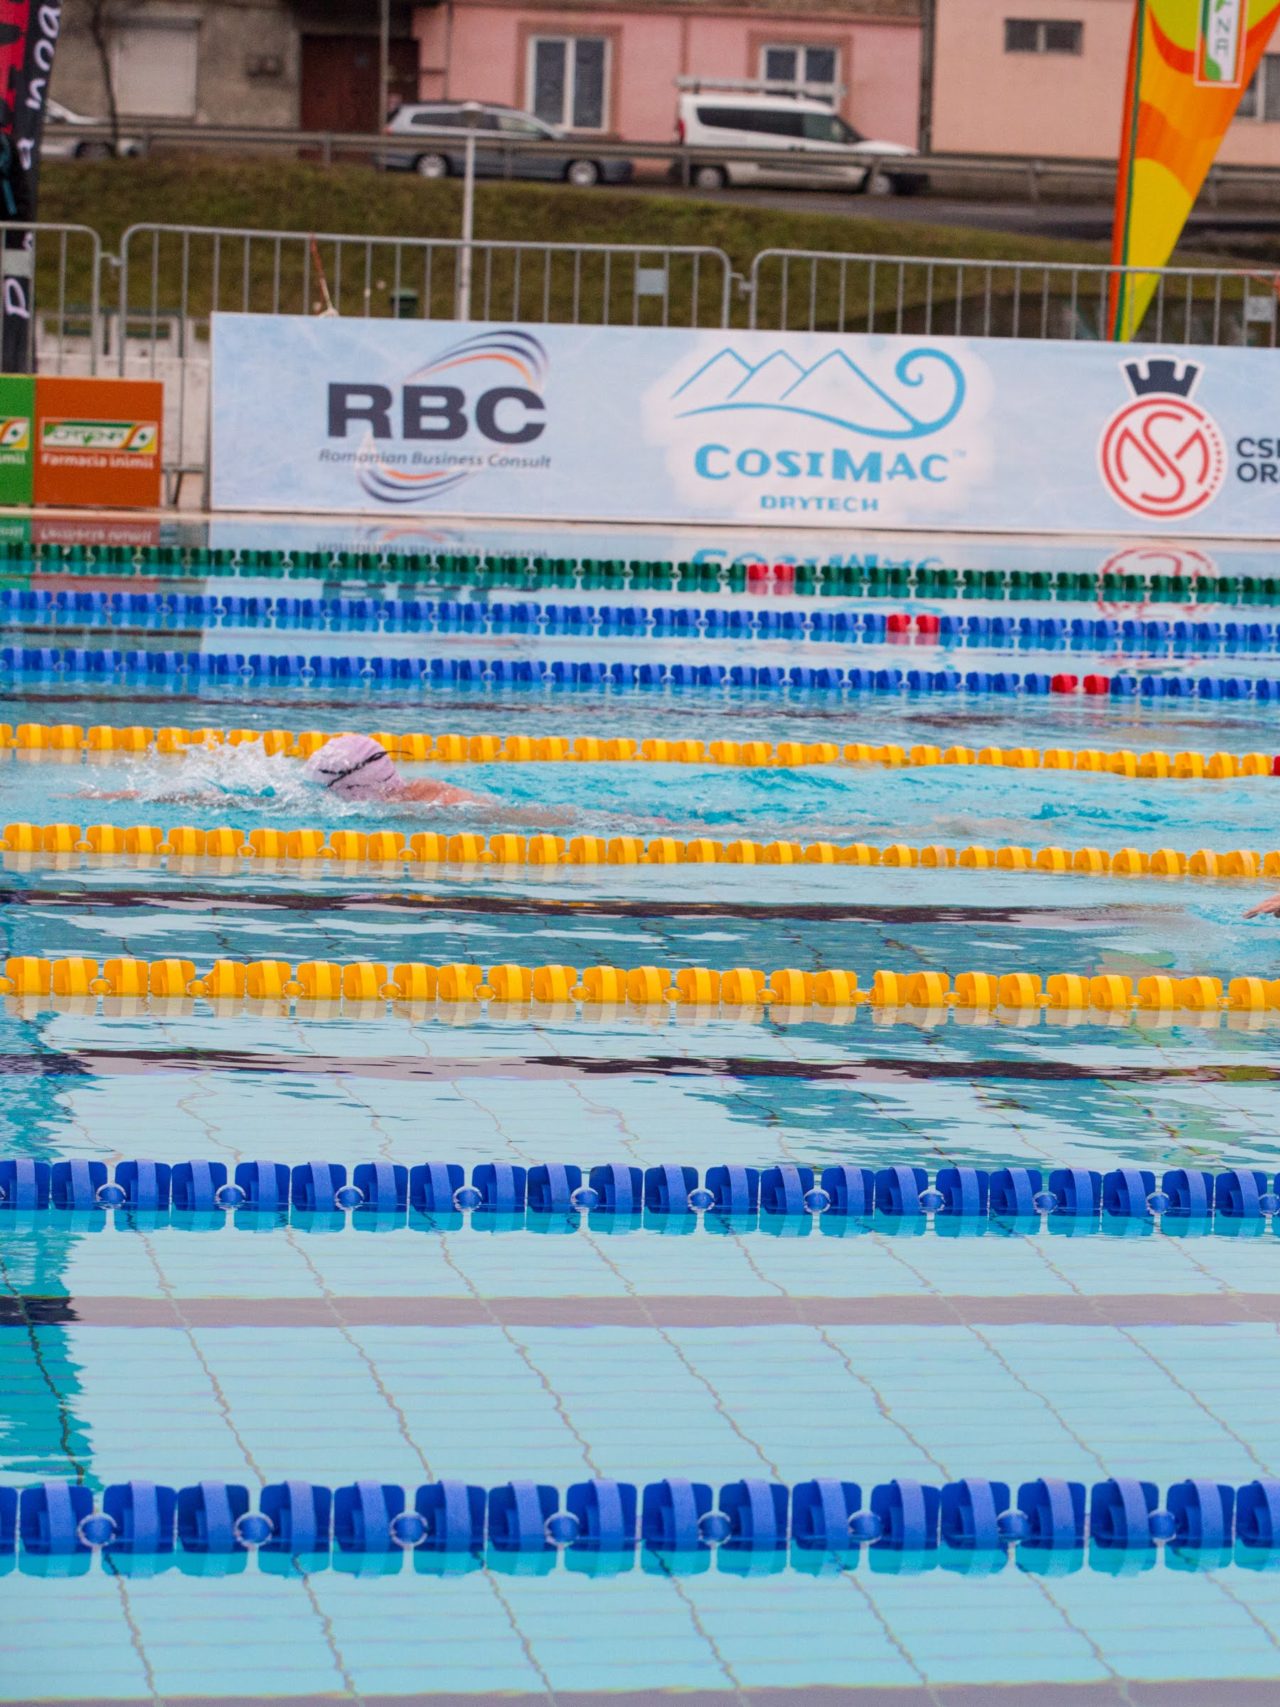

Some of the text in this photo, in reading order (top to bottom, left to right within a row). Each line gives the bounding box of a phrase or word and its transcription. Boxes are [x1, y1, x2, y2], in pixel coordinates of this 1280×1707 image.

[328, 383, 546, 443] RBC
[42, 452, 107, 467] Farmacia
[318, 449, 551, 468] Romanian Business Consult
[760, 495, 879, 512] DRYTECH
